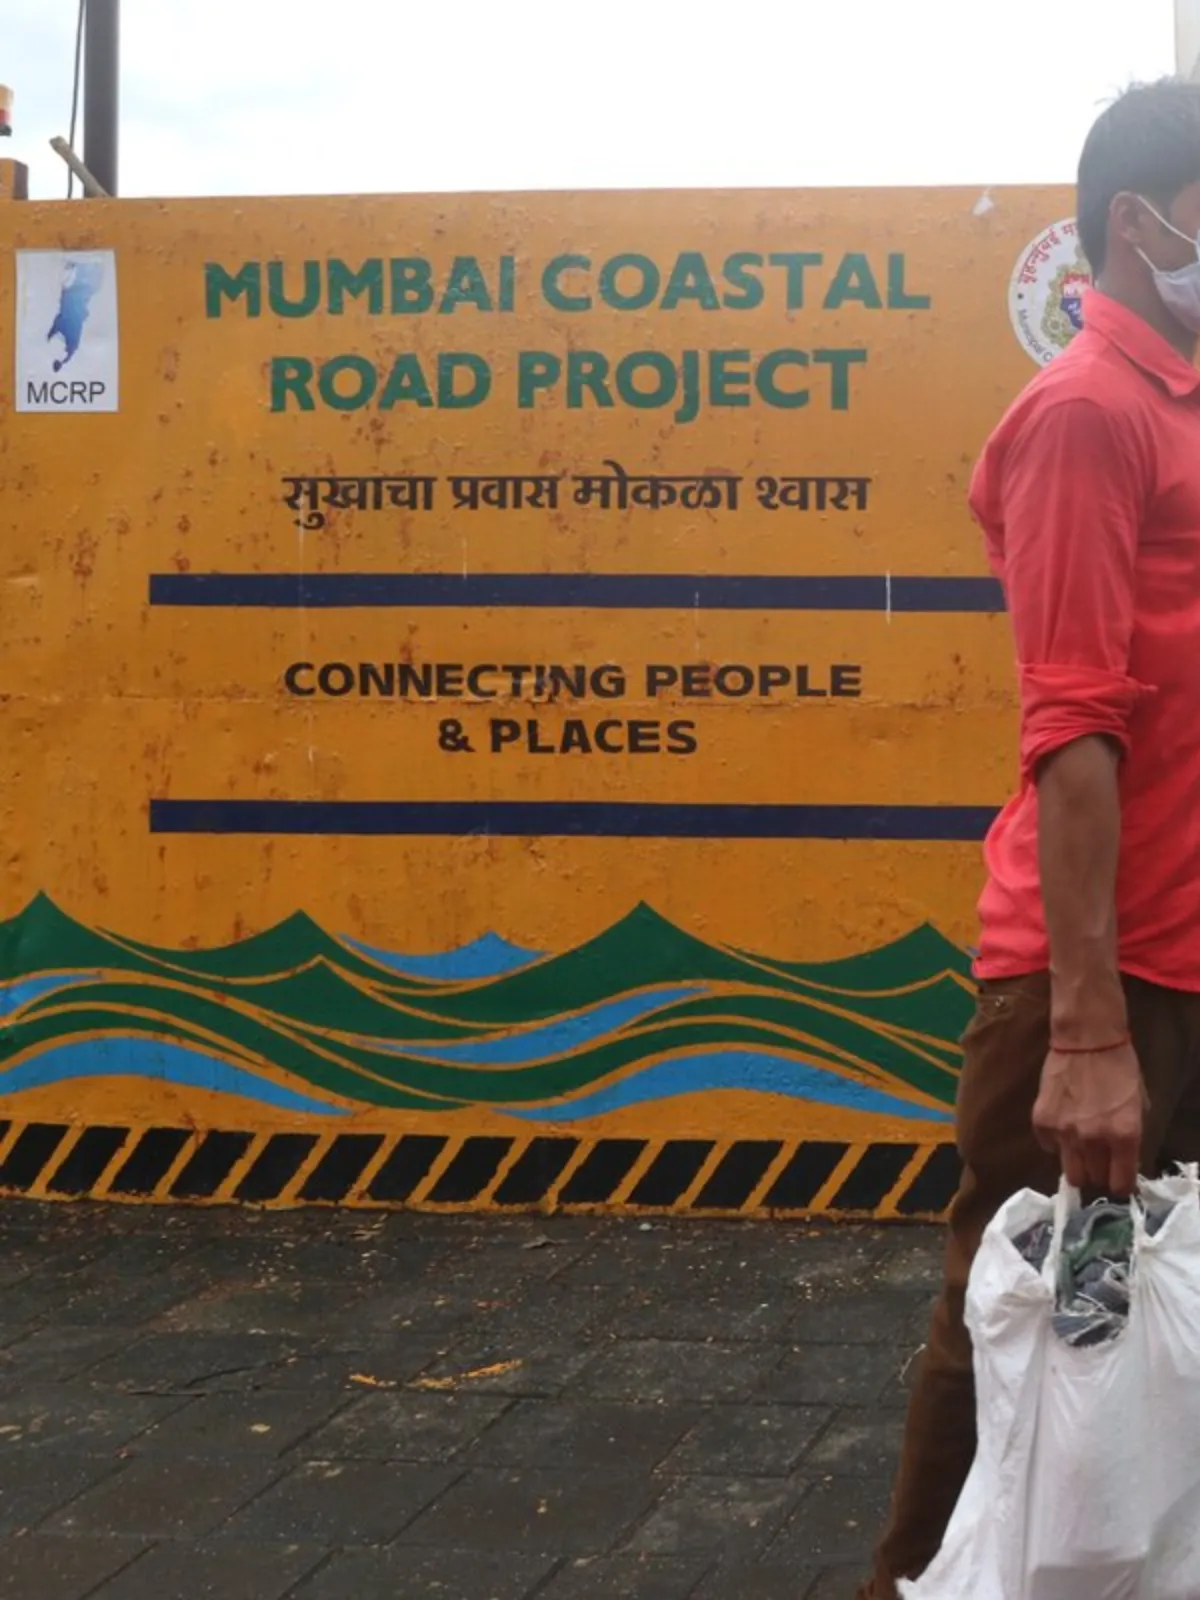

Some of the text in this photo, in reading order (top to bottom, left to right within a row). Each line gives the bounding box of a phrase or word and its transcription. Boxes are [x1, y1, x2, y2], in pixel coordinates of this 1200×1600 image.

[204, 250, 931, 318] MUMBAI COASTAL
[26, 381, 107, 405] MCRP
[271, 348, 867, 424] ROAD PROJECT
[281, 459, 872, 530] सुखाचा प्रवास मोकळा श्वास
[284, 662, 862, 698] CONNECTING PEOPLE
[437, 718, 698, 755] & PLACES
